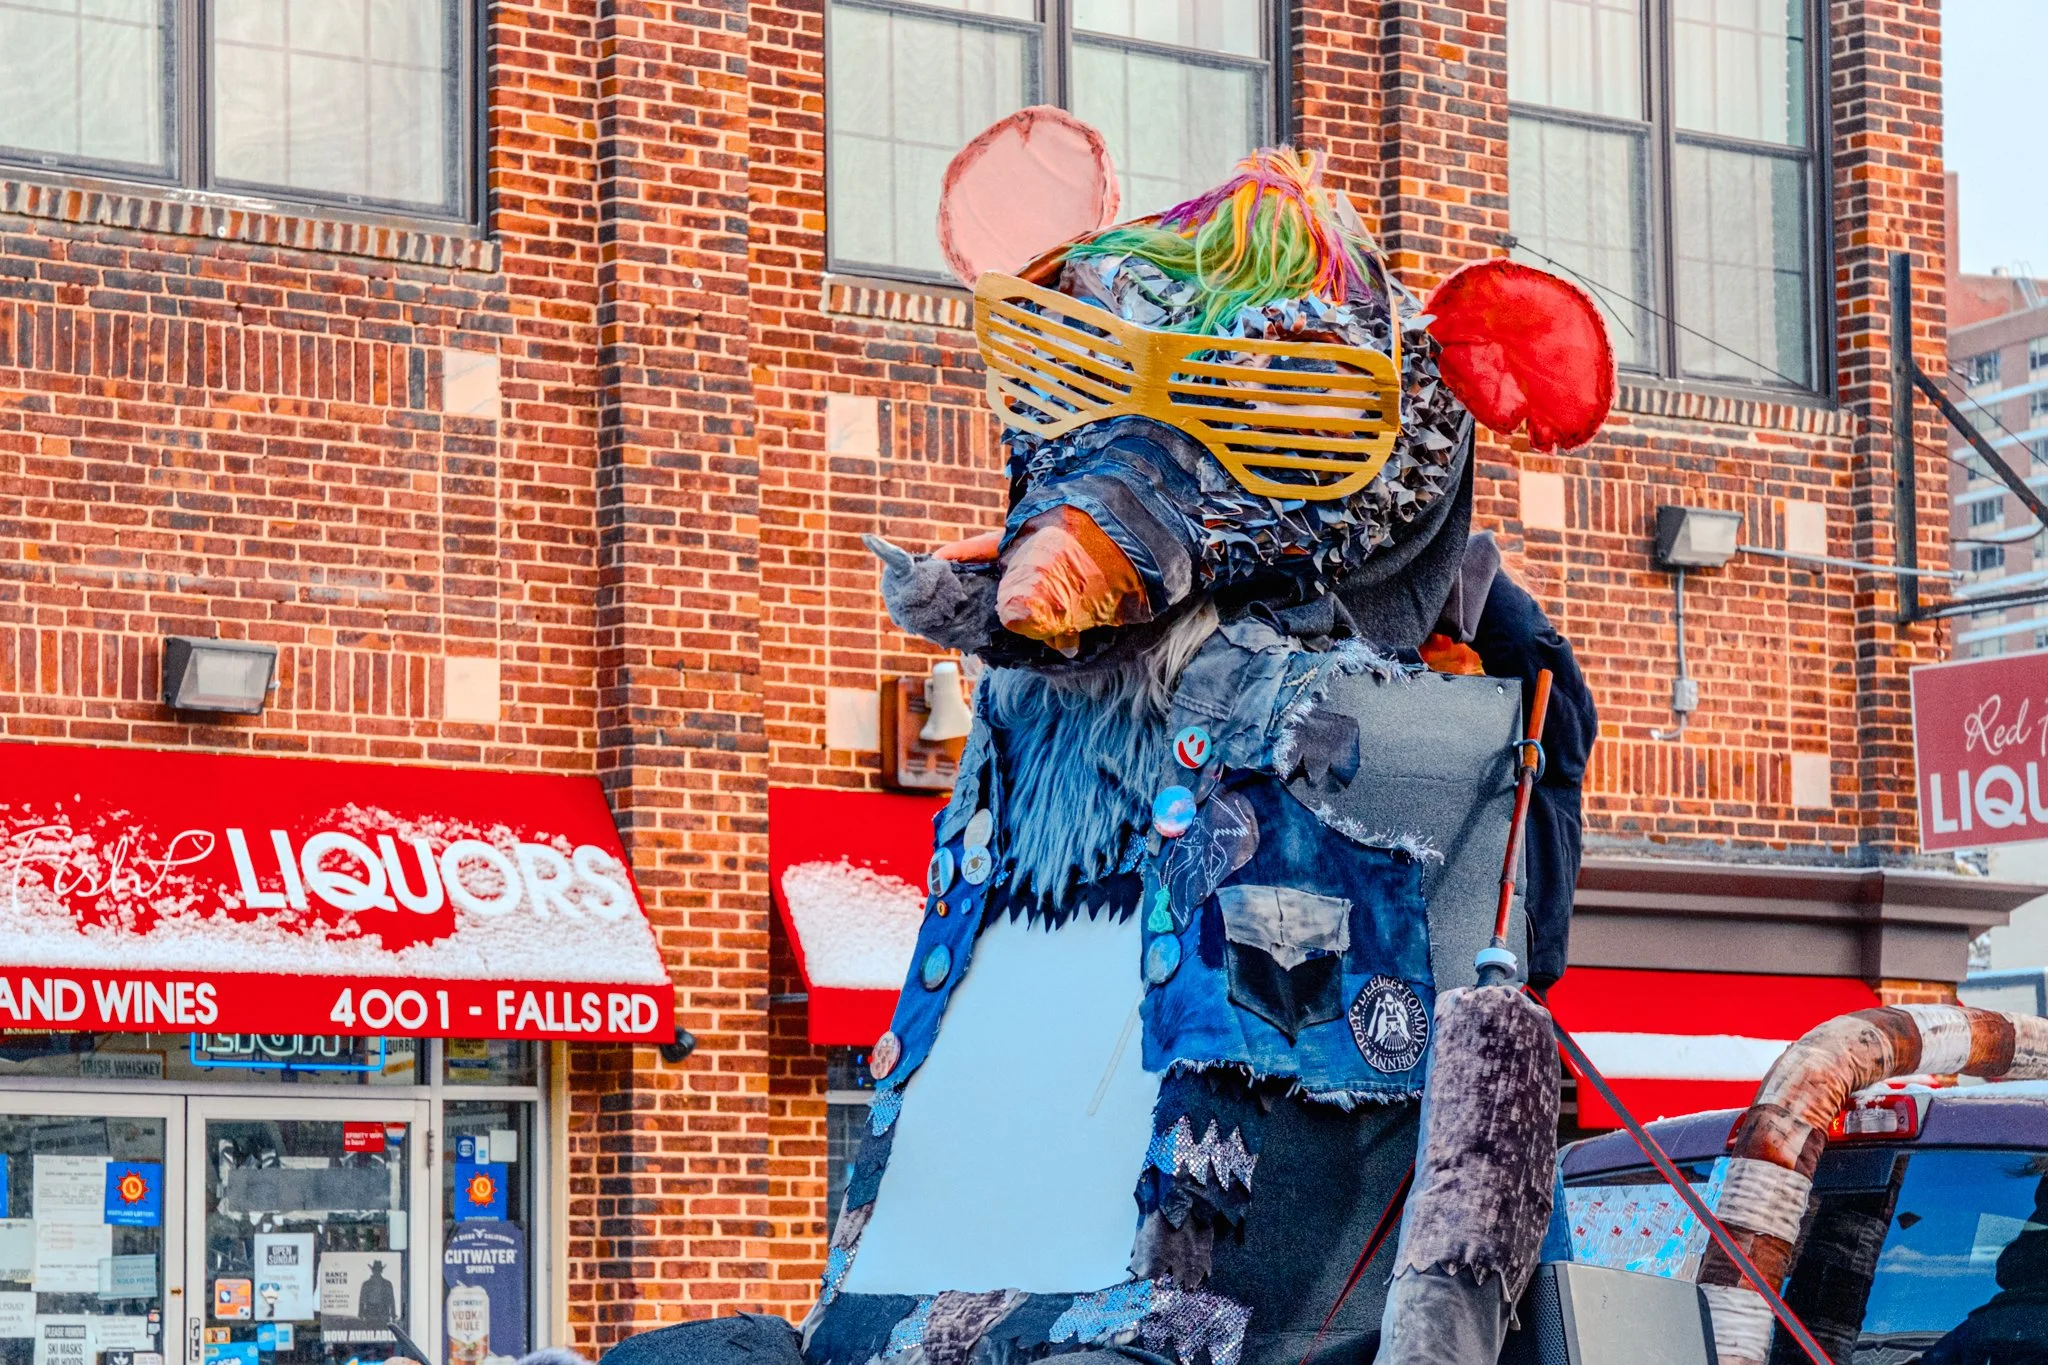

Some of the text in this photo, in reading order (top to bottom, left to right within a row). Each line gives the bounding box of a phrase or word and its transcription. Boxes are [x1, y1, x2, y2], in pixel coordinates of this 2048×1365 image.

[1964, 694, 2031, 756] Red
[226, 828, 632, 920] LIQUORS
[0, 977, 219, 1025] AND WINES
[330, 988, 450, 1029] 4001
[497, 990, 602, 1032] FALLS
[608, 994, 659, 1033] RD
[1403, 986, 1426, 1047] TOMMY
[1350, 1010, 1369, 1052] JOEY
[81, 1059, 160, 1075] IRISH WHISKEY
[1370, 1051, 1416, 1070] JOHNNY
[271, 1246, 292, 1255] OPEN
[444, 1249, 516, 1264] CUTWATER
[268, 1255, 297, 1265] SUNDAY
[465, 1265, 495, 1274] SPIRITS
[452, 1311, 482, 1320] VODKA
[46, 1326, 64, 1338] PLEASE
[455, 1321, 480, 1331] MULE
[189, 1318, 200, 1361] PULL
[323, 1330, 348, 1342] NOW
[47, 1343, 83, 1356] SKI MASKS
